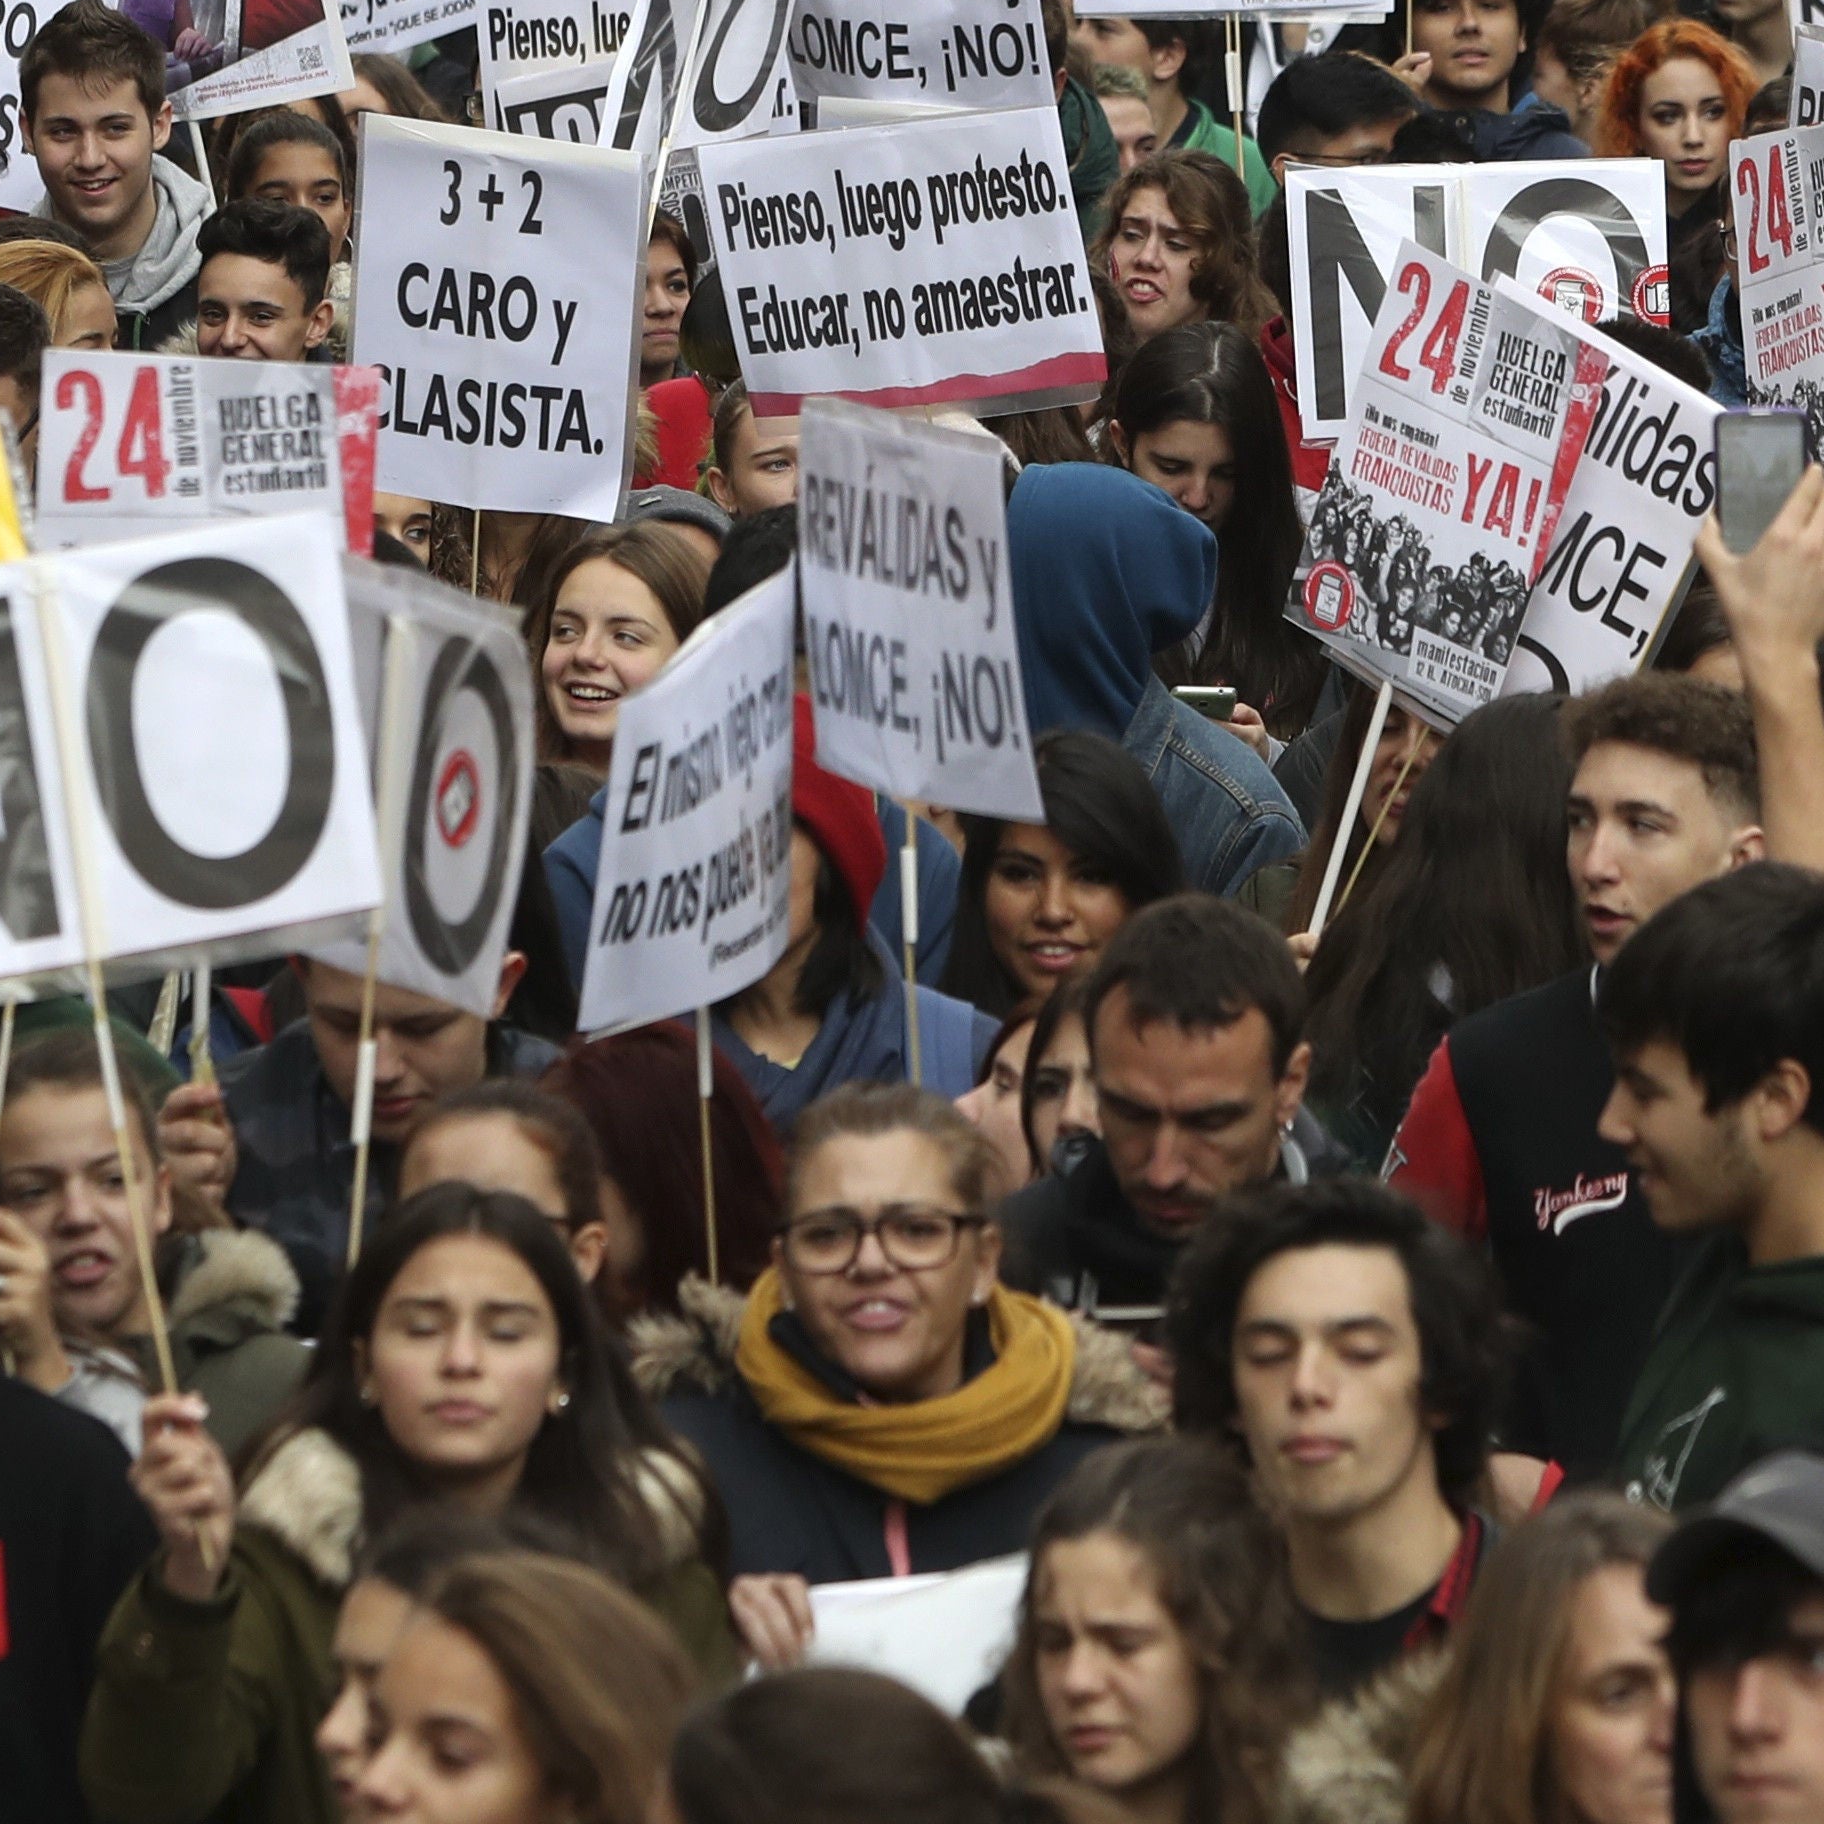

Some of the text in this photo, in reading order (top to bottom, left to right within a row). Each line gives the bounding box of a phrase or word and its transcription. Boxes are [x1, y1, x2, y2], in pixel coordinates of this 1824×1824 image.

[717, 146, 1069, 255] Pienso, luego protesto.
[1736, 143, 1794, 275] 24
[1784, 137, 1807, 226] noviembre
[1794, 232, 1808, 253] de
[396, 261, 578, 366] CARO y
[737, 256, 1089, 358] Educar, no amaestrar.
[1304, 178, 1650, 423] NO
[1377, 260, 1471, 396] 24
[1459, 288, 1493, 381] noviembre
[1449, 384, 1470, 405] de
[1488, 364, 1560, 416] GENERAL
[1496, 330, 1569, 386] HUELGA
[53, 365, 173, 504] 24
[217, 391, 324, 432] HUELGA
[220, 426, 328, 465] GENERAL
[1481, 397, 1557, 442] estudiantil
[222, 462, 330, 496] estudiantil
[1350, 447, 1457, 517] FRANQUISTAS
[1461, 452, 1544, 550] YA!
[803, 462, 999, 632] REVÁLIDAS y
[599, 881, 646, 946] no
[645, 861, 698, 940] nos
